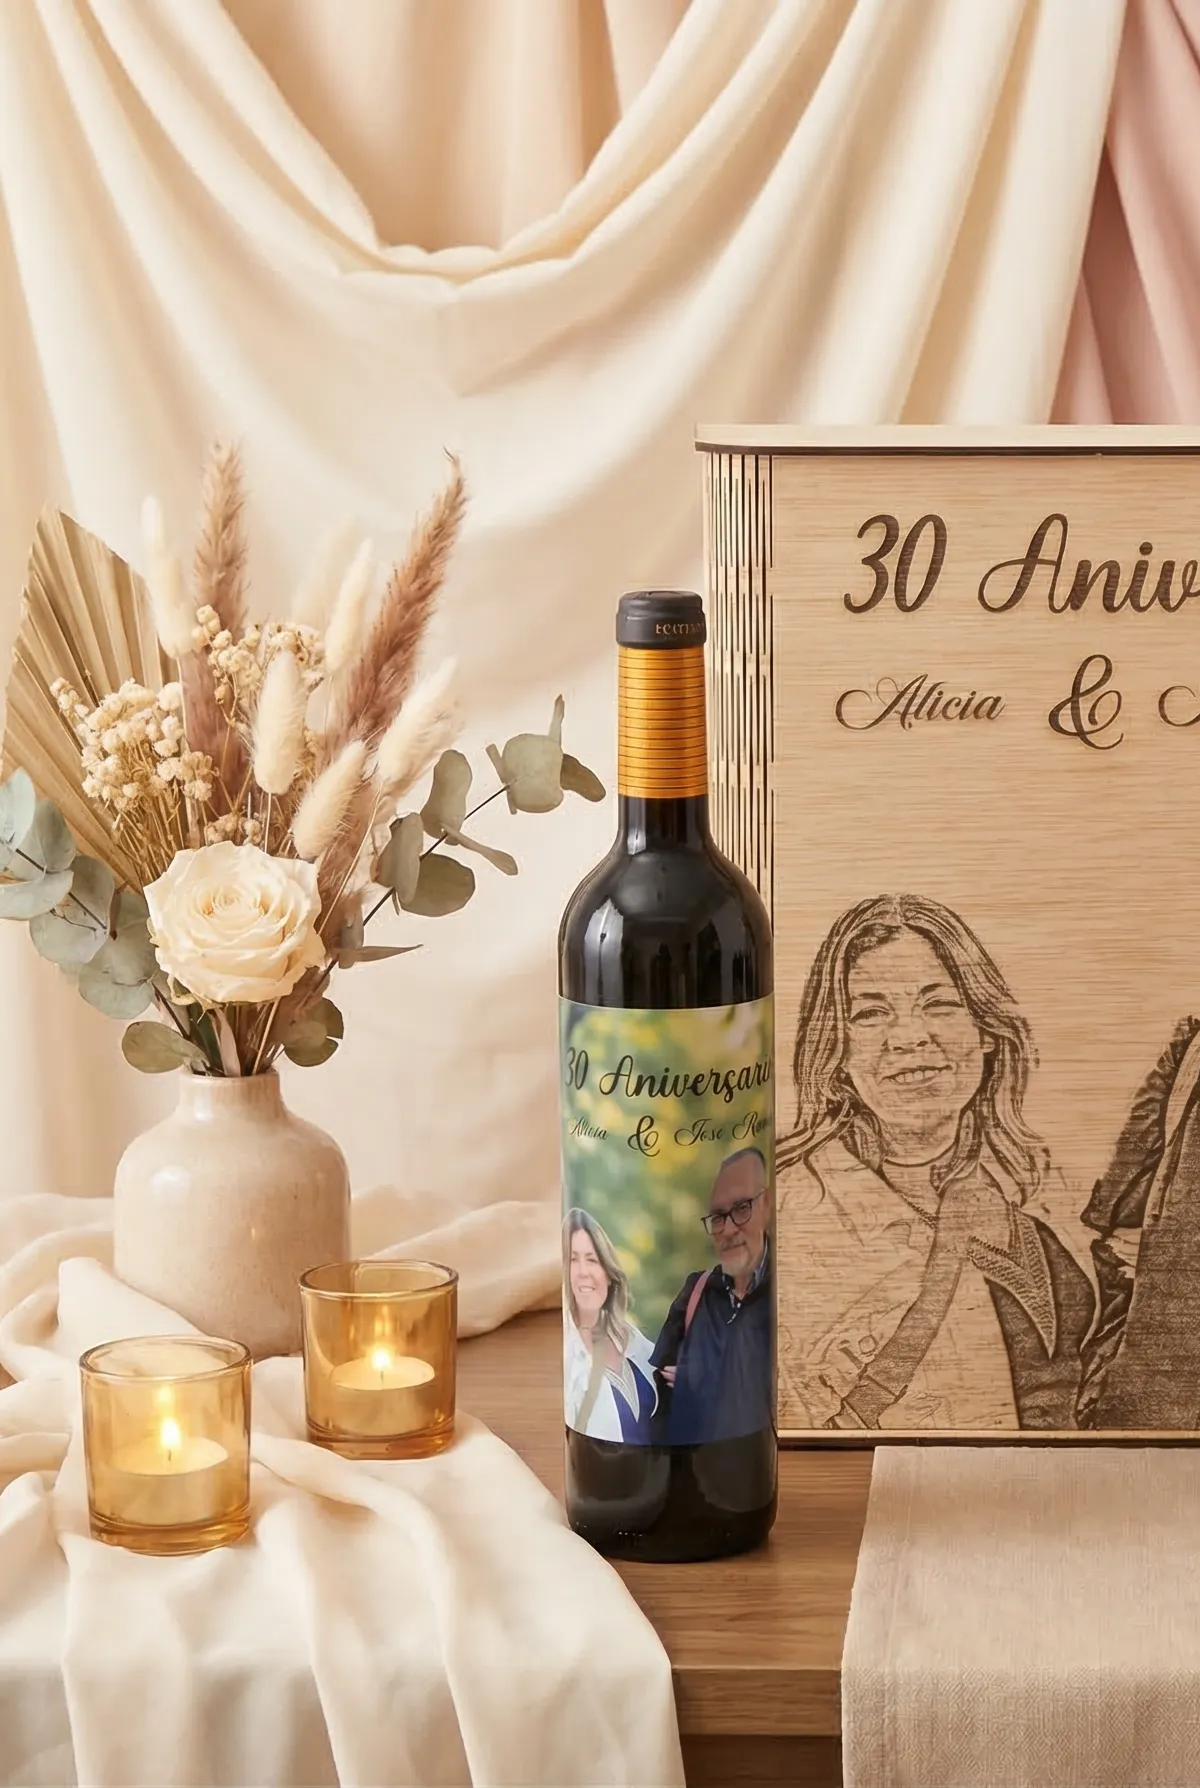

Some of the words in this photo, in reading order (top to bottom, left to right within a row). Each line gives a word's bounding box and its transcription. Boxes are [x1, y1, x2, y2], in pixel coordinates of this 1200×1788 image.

[843, 513, 948, 615] 30
[835, 673, 1006, 731] Alicia
[1048, 654, 1124, 751] &
[627, 1115, 660, 1158] &
